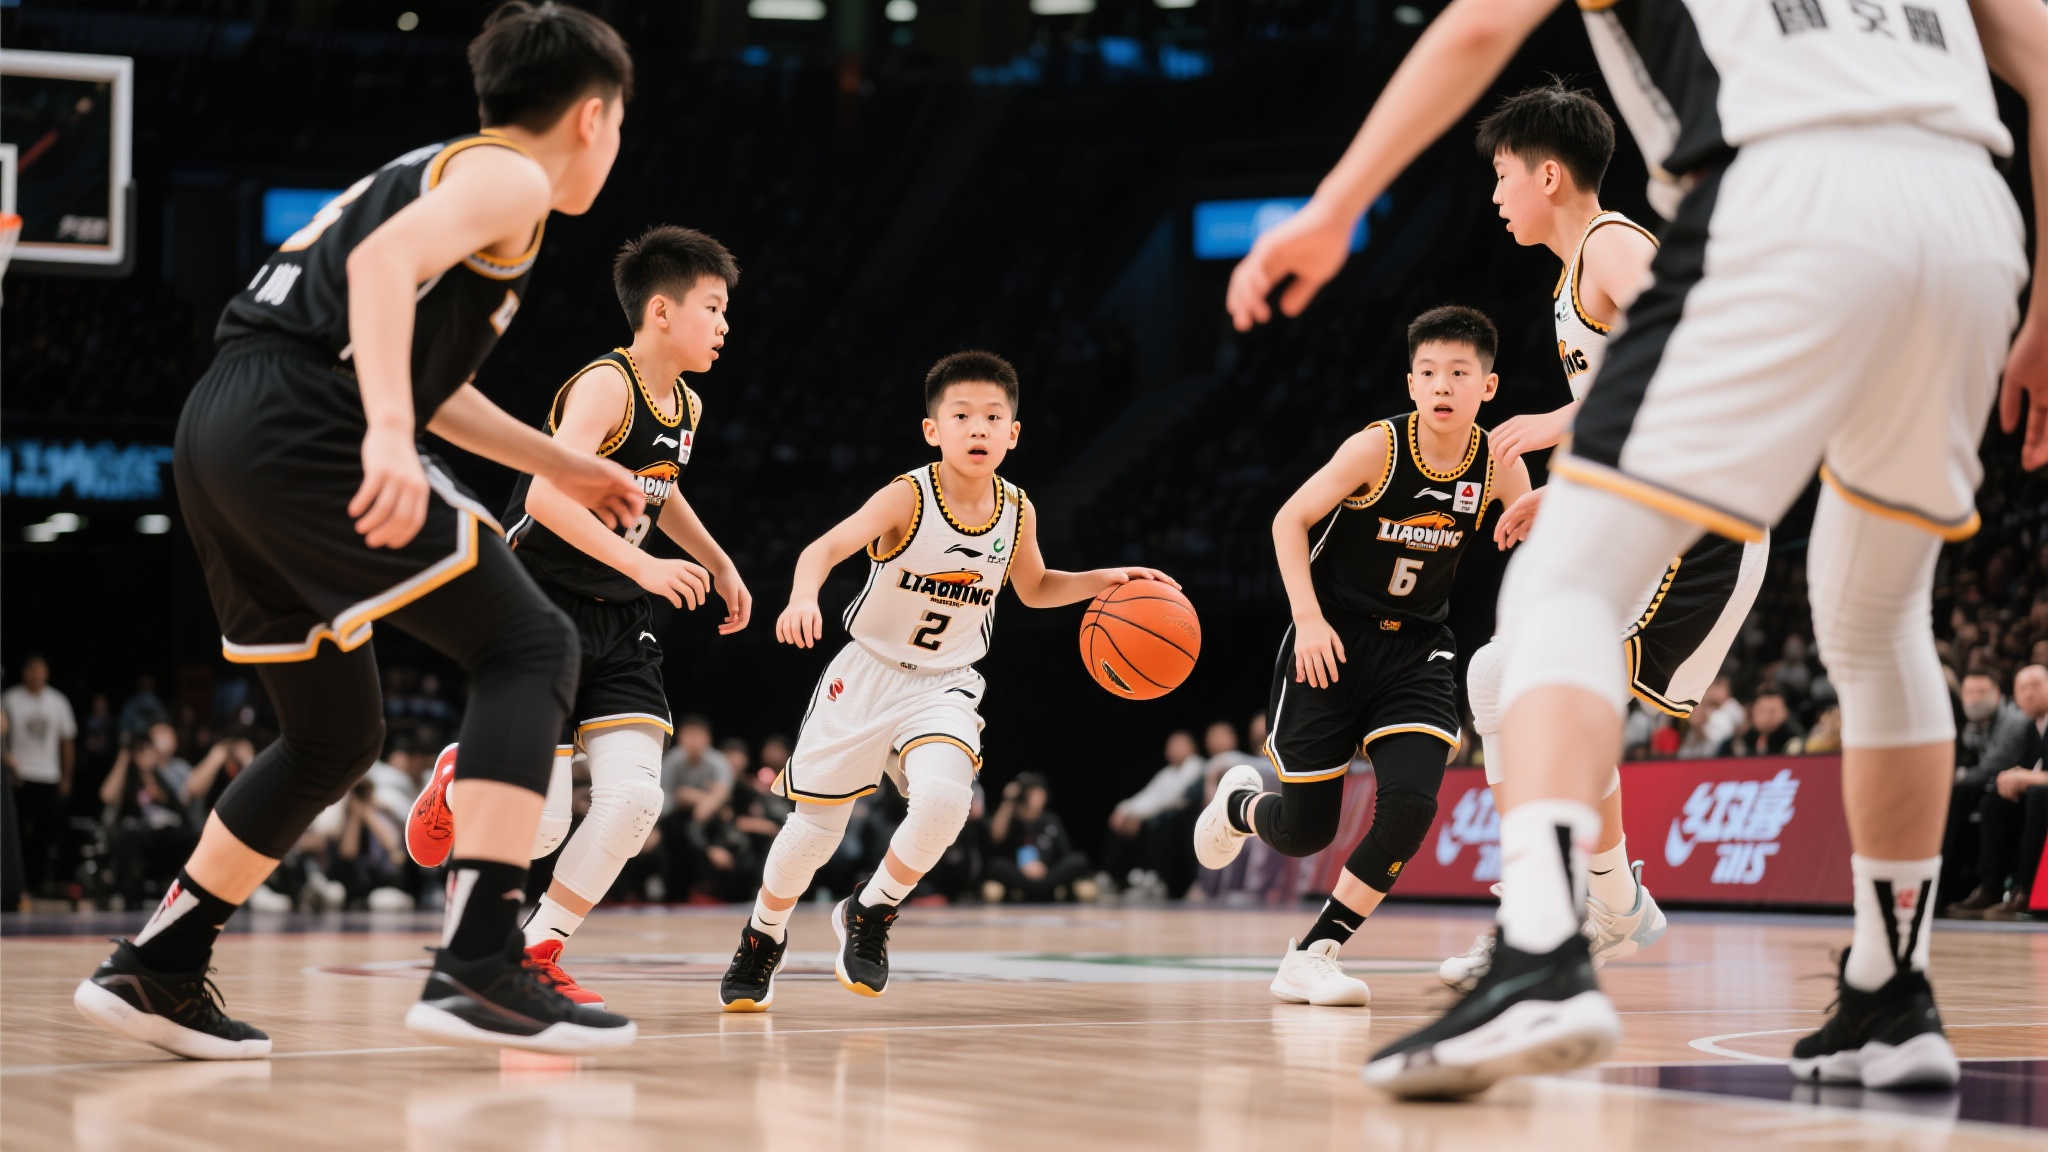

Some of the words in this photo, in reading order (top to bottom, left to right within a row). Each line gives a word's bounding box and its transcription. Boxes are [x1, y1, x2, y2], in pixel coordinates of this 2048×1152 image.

[898, 568, 994, 607] LIAONING
[1388, 557, 1424, 597] 6
[907, 609, 952, 651] 2
